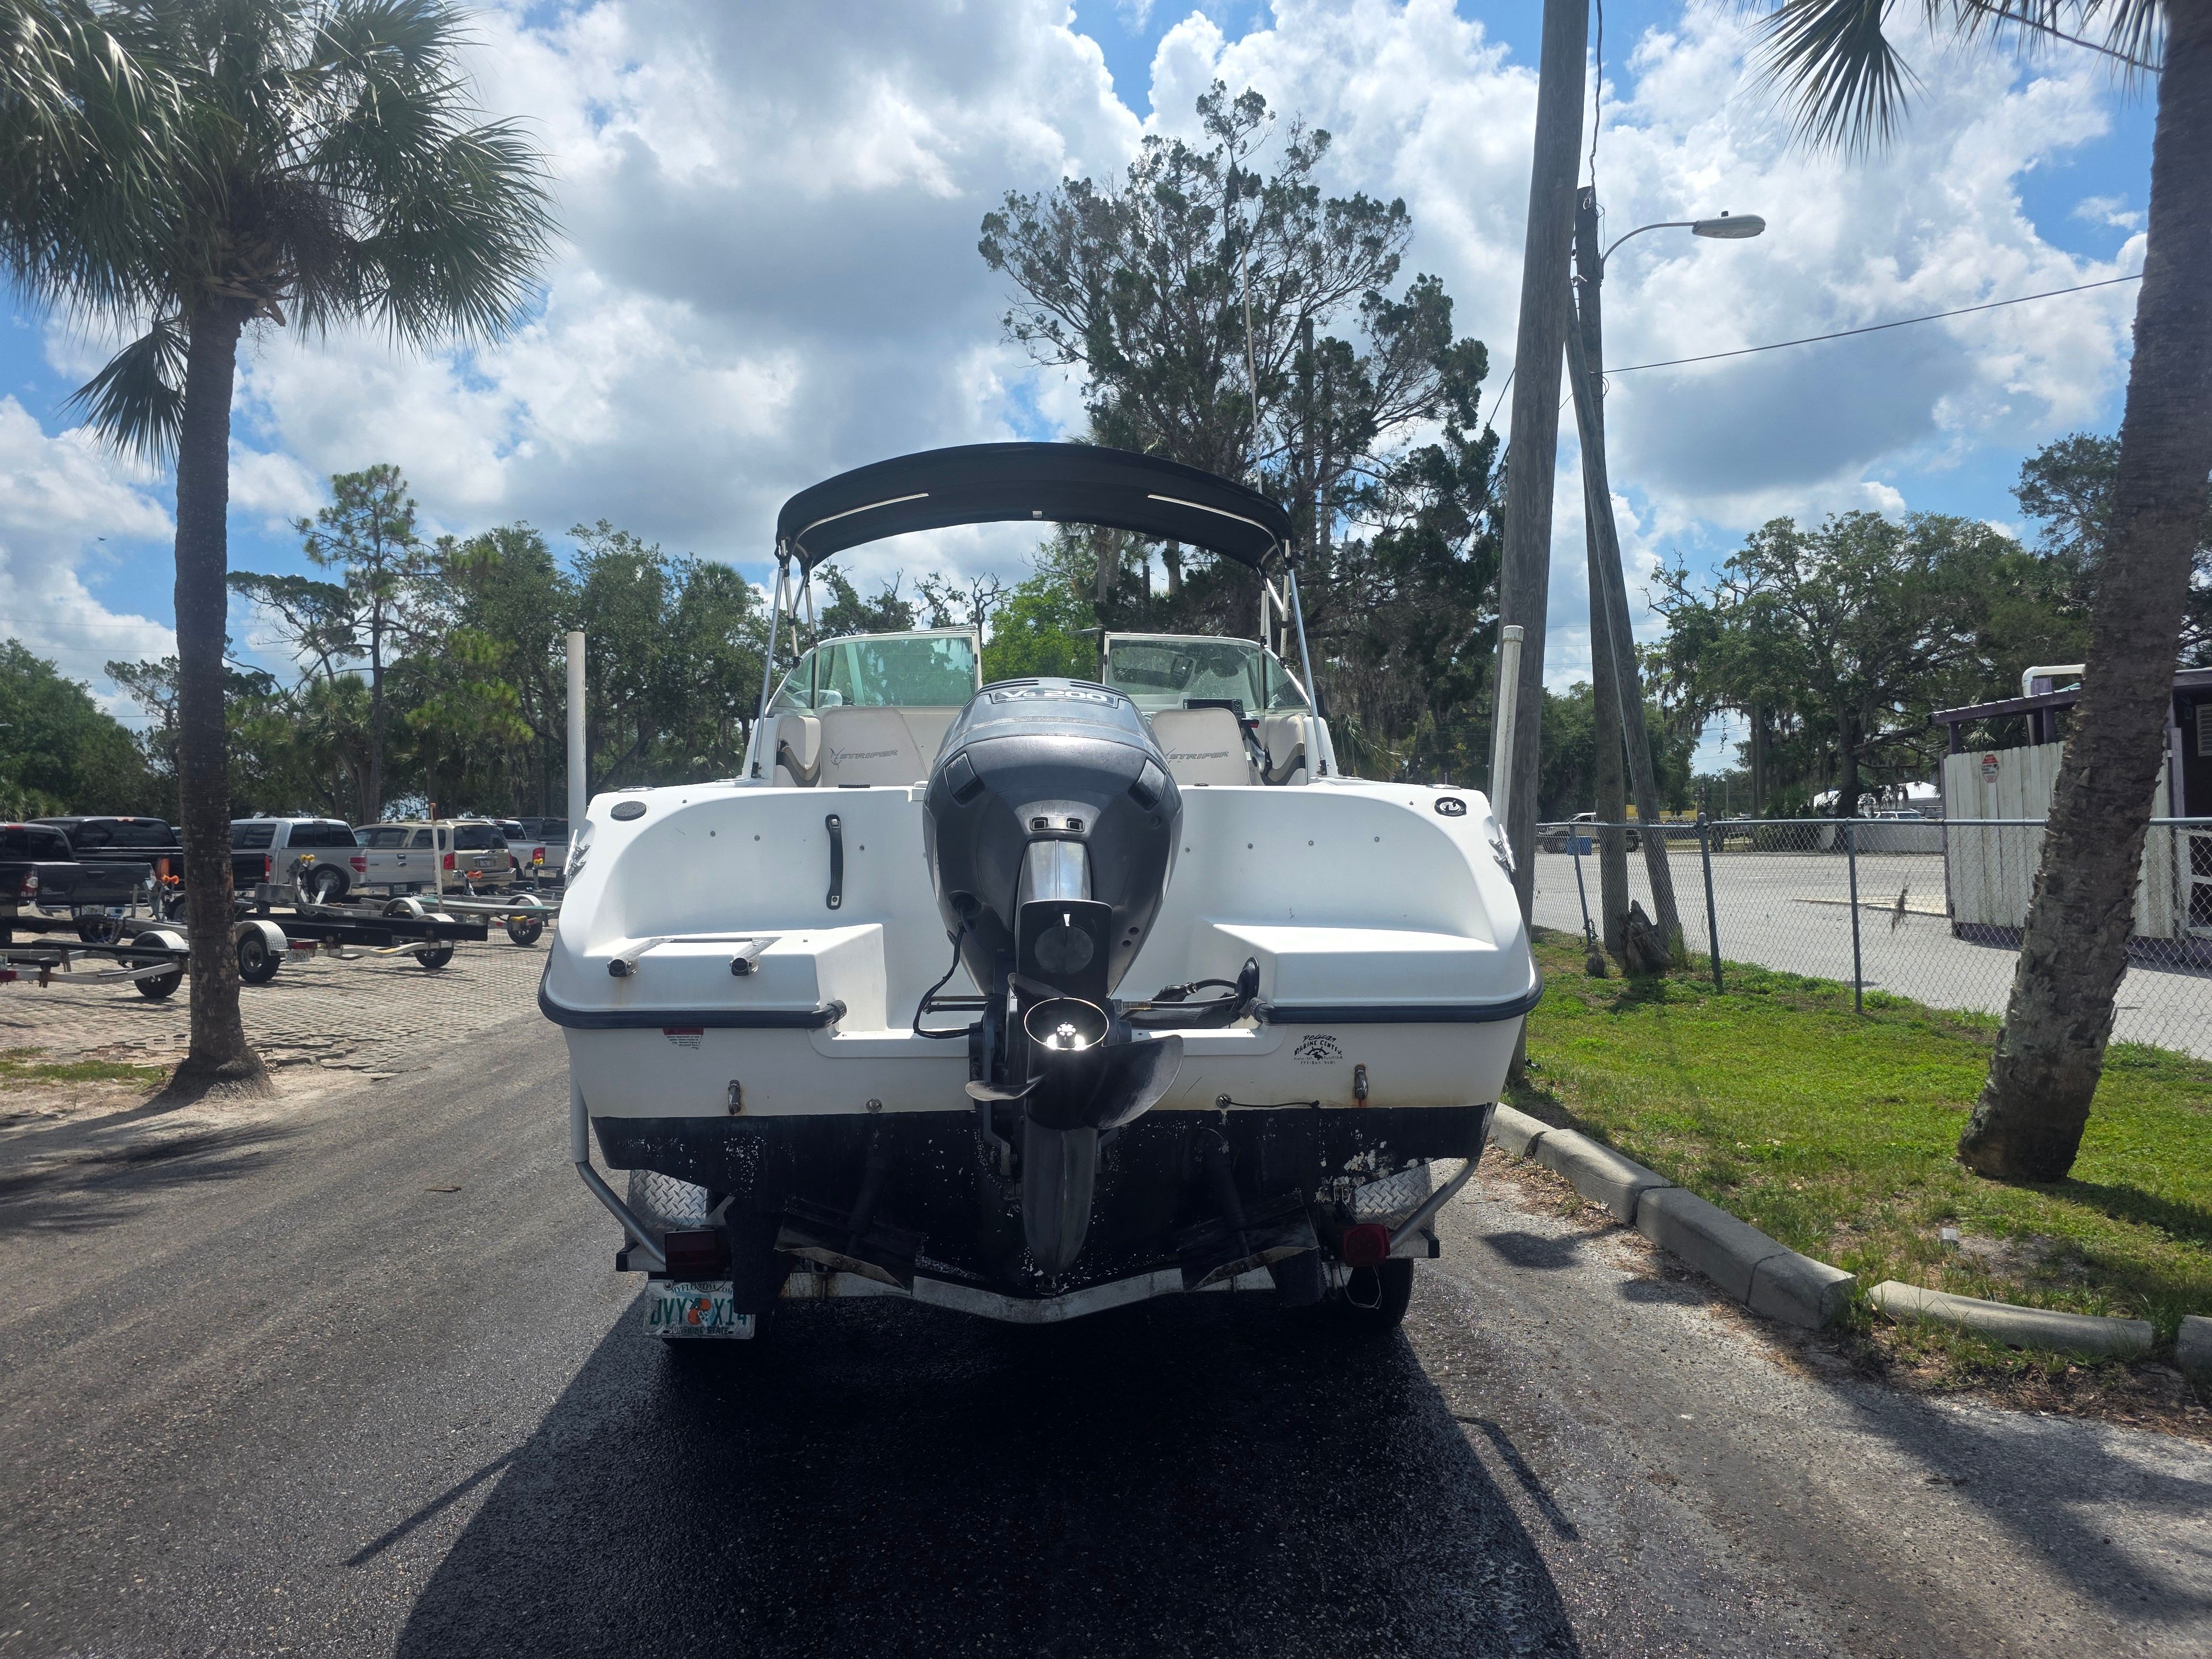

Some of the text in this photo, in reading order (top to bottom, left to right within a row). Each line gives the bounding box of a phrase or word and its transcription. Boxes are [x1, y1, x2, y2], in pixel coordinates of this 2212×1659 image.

[1044, 690, 1107, 702] 200
[840, 749, 899, 759] STRIPER
[1169, 750, 1229, 760] STRIPER
[1294, 1040, 1343, 1056] MARINE CENTER
[707, 1325, 728, 1334] STATE
